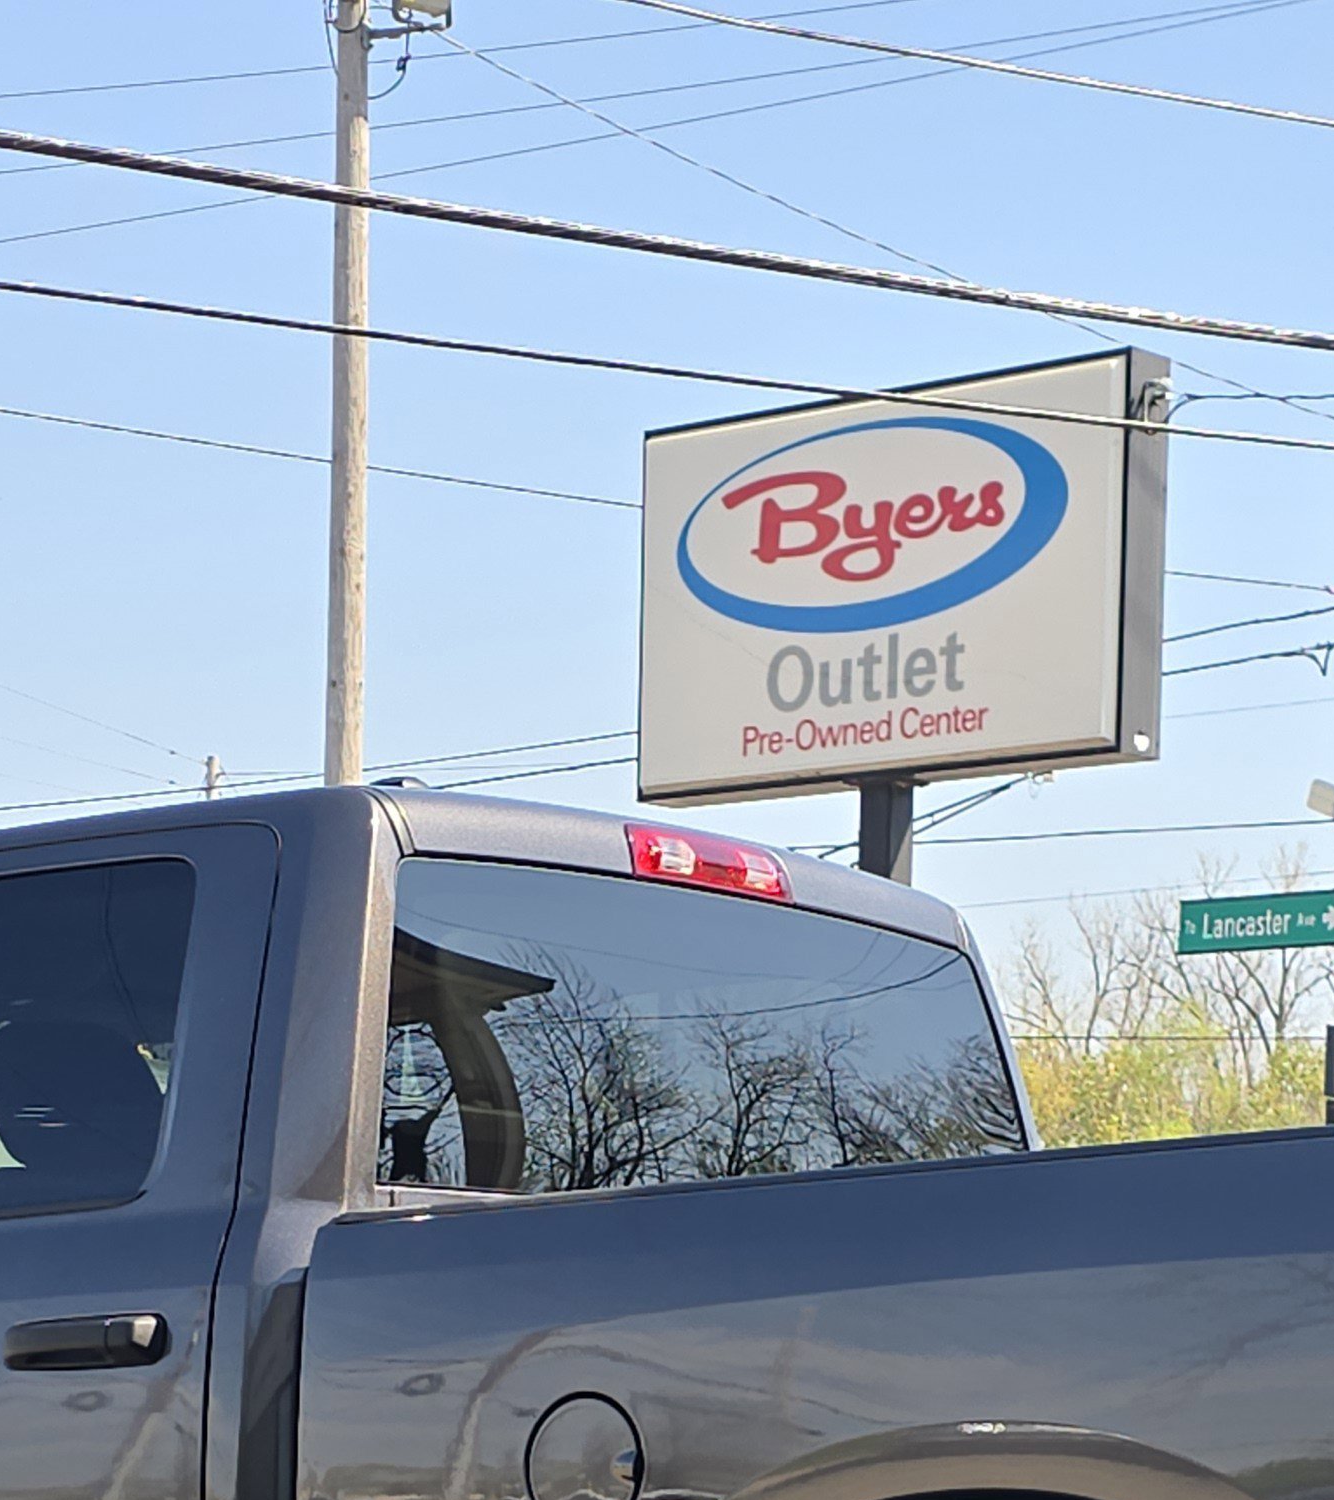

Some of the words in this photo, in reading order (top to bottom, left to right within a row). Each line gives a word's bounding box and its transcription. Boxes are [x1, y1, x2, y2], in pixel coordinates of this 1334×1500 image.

[721, 471, 1005, 581] Byers
[767, 632, 965, 712] Outlet
[742, 710, 893, 756] Pre-Owned
[899, 705, 989, 738] Center
[1202, 909, 1292, 940] Lancaster
